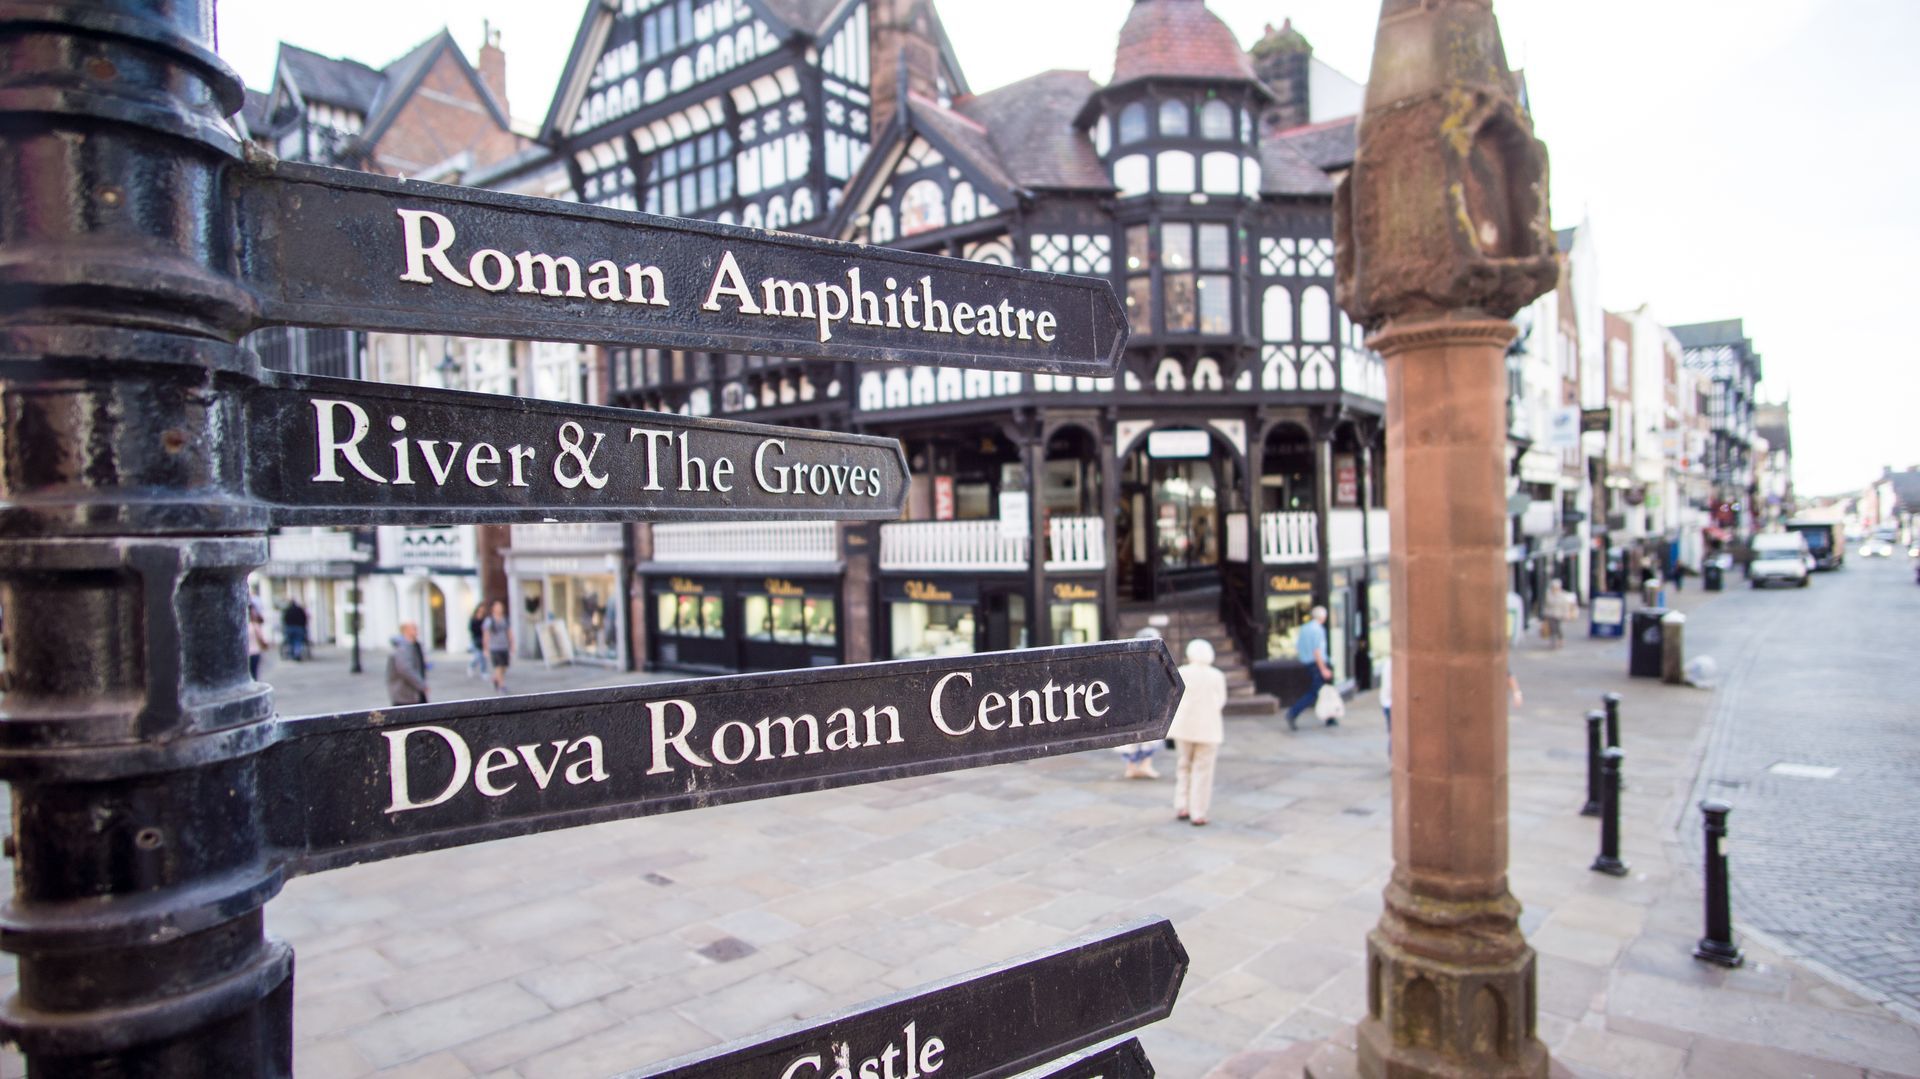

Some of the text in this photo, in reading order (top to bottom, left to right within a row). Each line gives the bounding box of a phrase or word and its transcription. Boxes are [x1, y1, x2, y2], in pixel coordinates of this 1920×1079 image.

[396, 207, 1058, 343] Roman Amphitheatre
[310, 398, 882, 497] River & The Groves
[381, 671, 1110, 814] Deva Roman Centre
